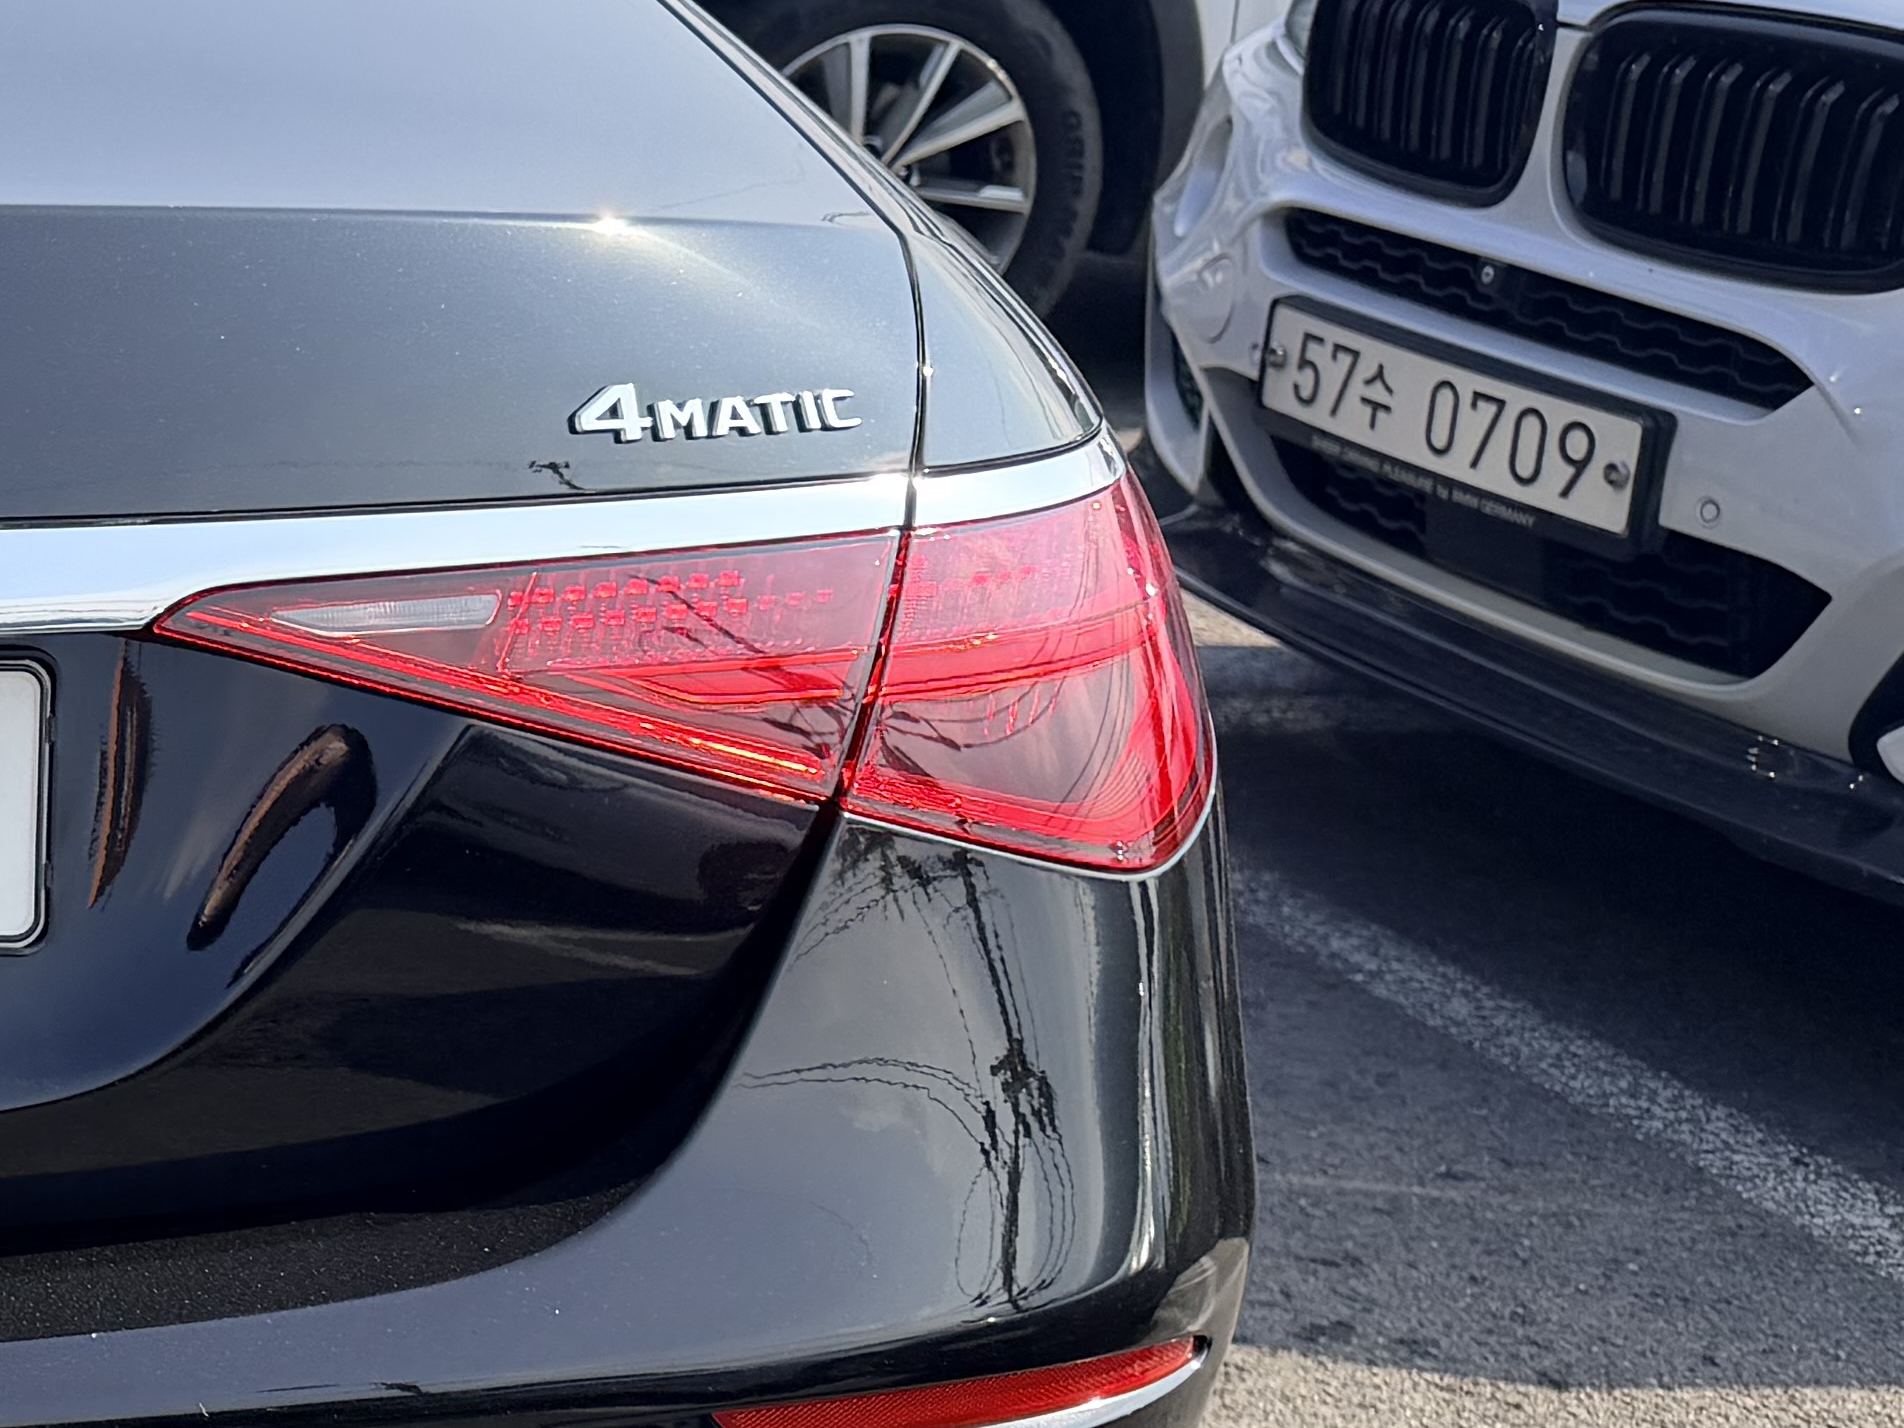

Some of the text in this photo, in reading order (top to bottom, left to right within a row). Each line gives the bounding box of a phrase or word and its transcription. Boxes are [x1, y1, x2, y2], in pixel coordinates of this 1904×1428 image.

[567, 382, 863, 445] 4MATIC
[1293, 331, 1597, 500] 57수 0709
